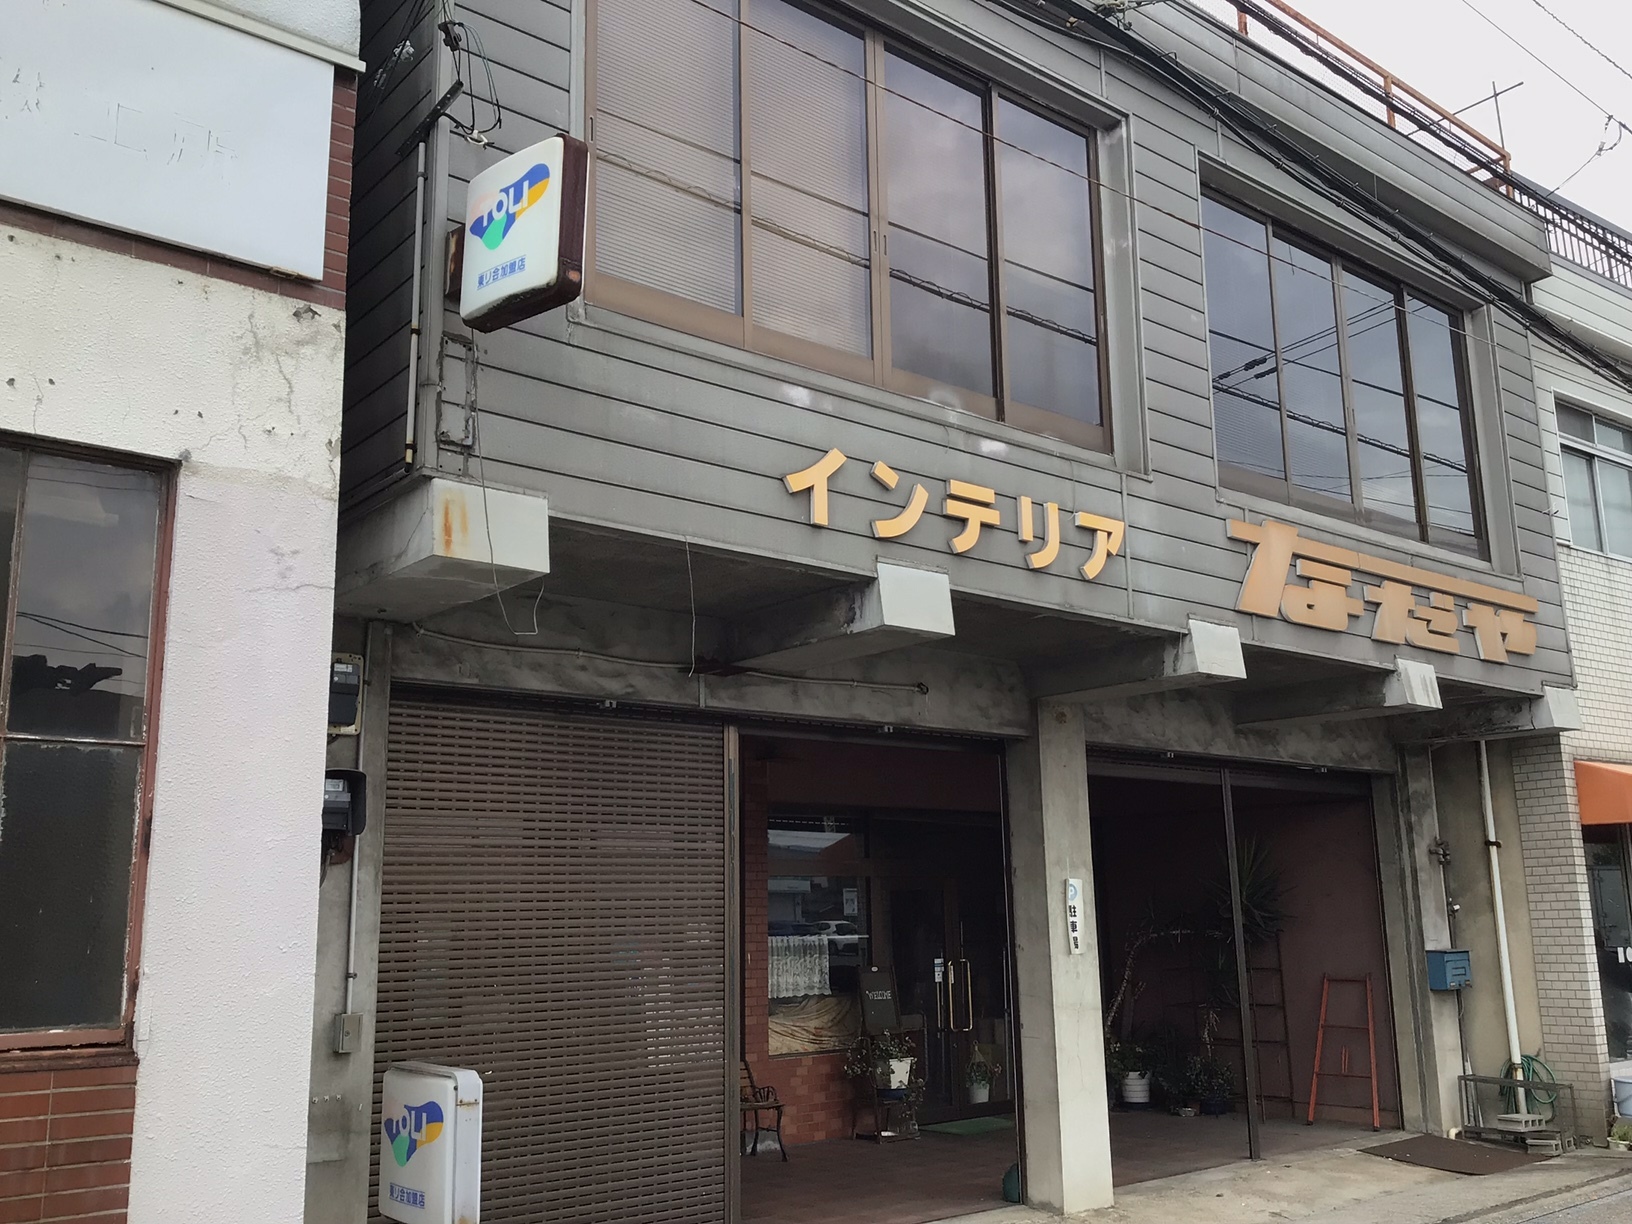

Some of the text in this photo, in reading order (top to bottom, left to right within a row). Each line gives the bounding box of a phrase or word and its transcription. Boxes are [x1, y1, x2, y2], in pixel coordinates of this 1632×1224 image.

[478, 180, 529, 227] TOLI
[783, 448, 1125, 581] インテリア
[387, 1111, 427, 1141] TOLI
